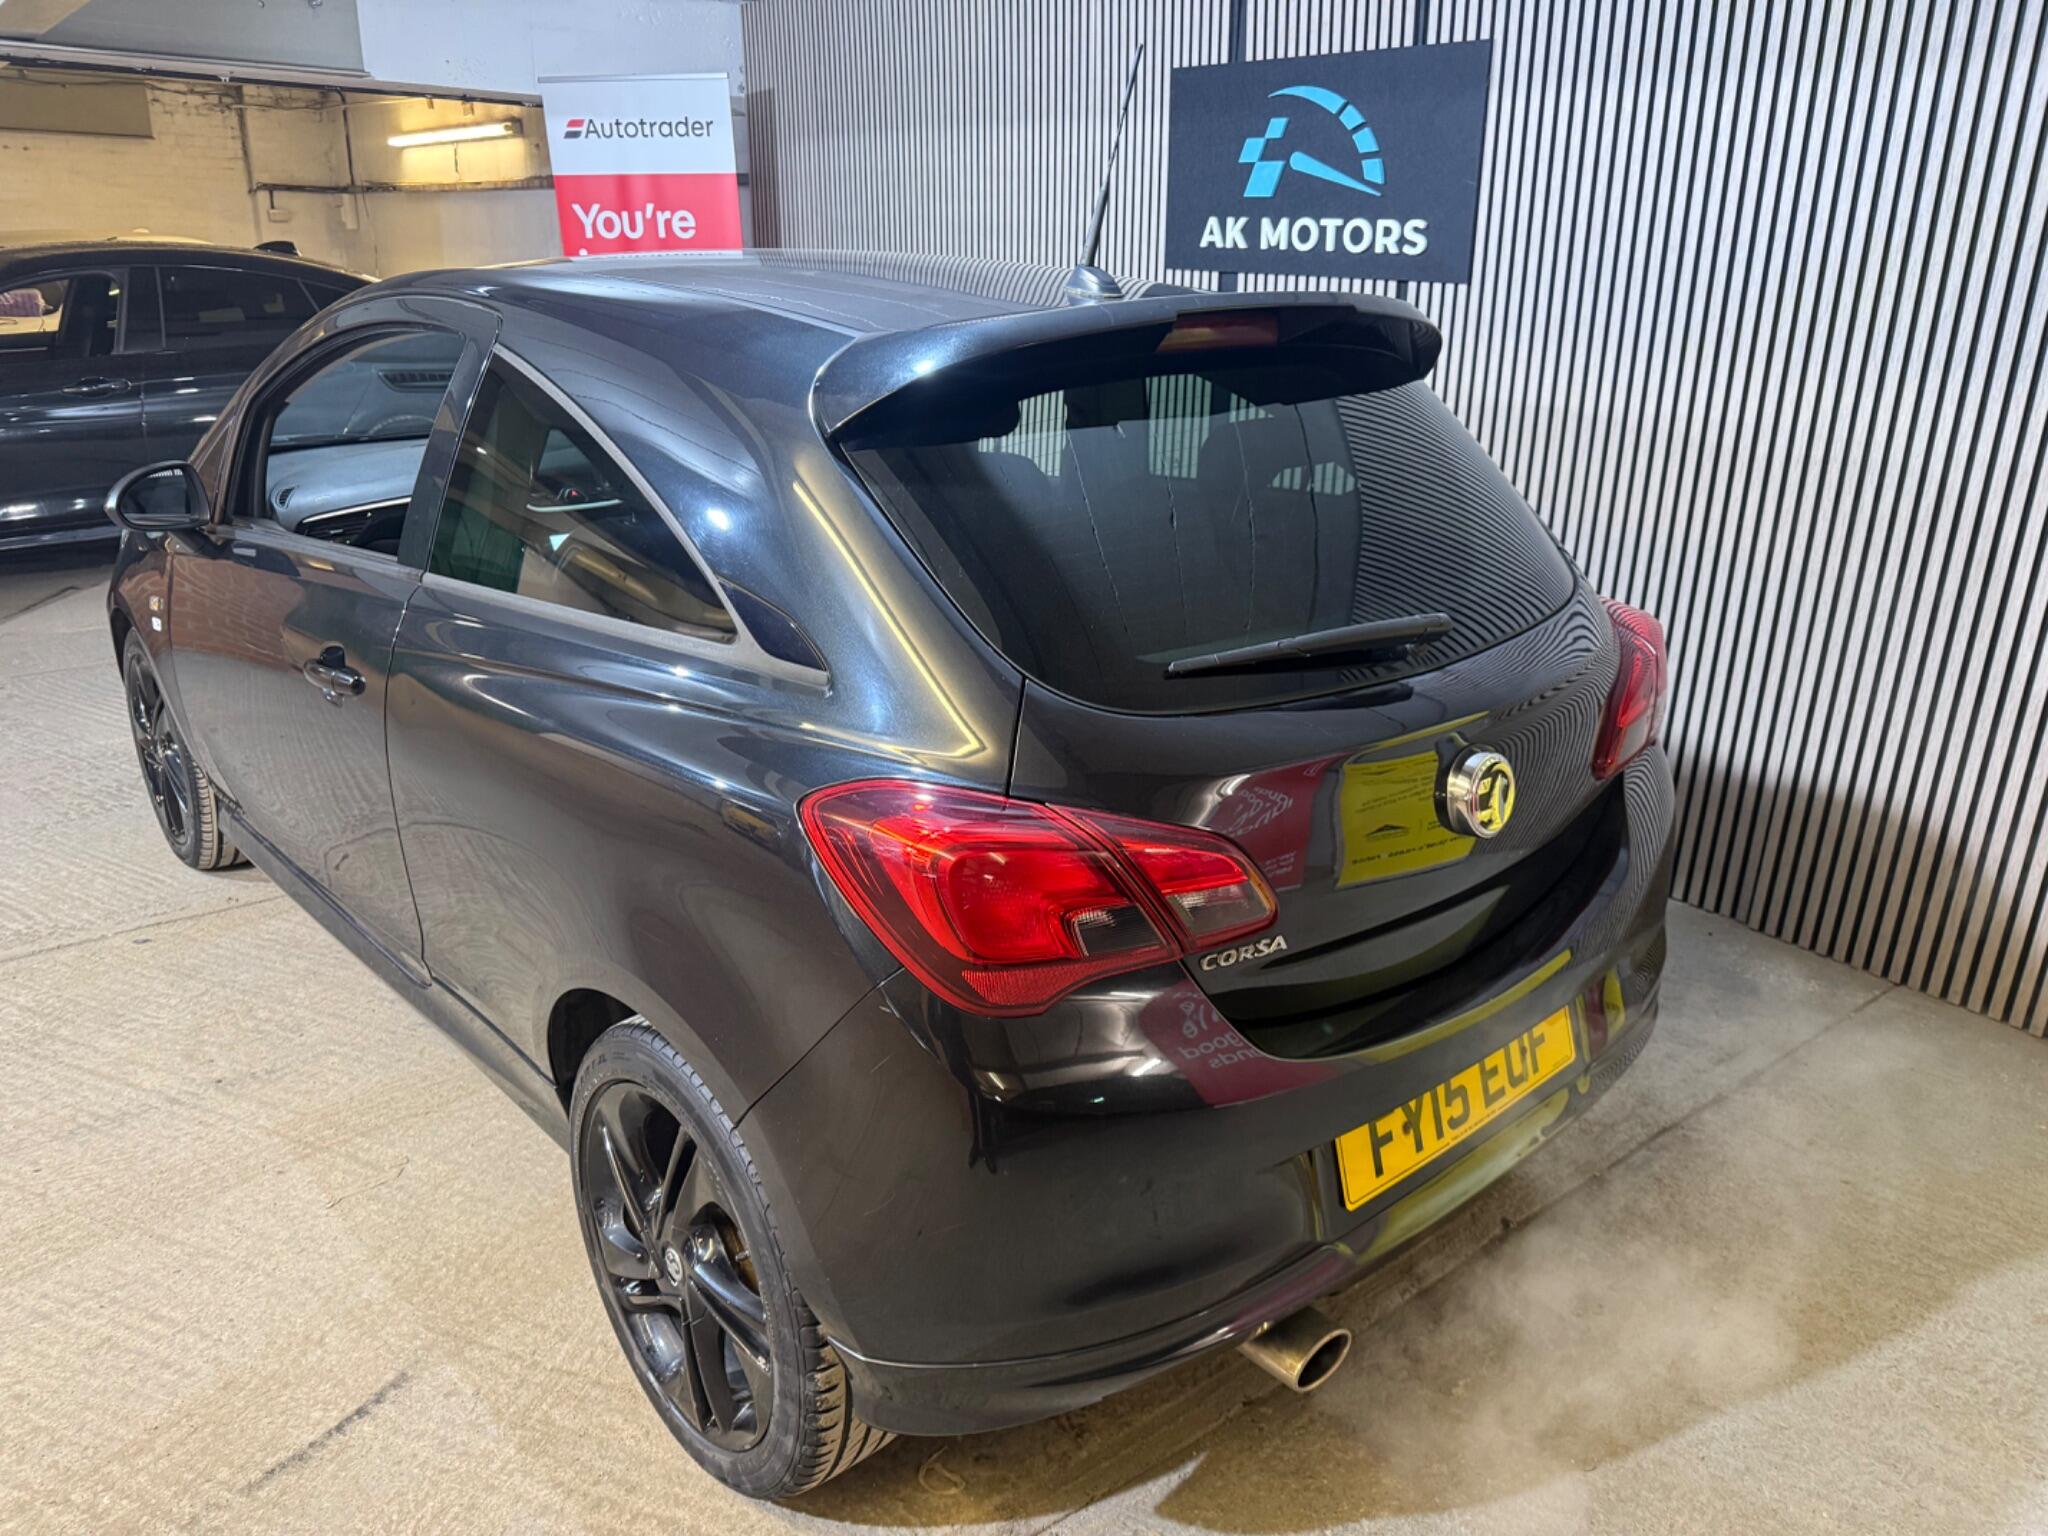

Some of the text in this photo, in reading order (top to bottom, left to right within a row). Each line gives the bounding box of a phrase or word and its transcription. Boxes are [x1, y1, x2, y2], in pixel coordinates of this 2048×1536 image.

[584, 116, 713, 139] Autotrader
[571, 203, 696, 239] You're
[1199, 216, 1429, 256] AK MOTORS
[1201, 935, 1288, 971] CORSA
[1368, 1026, 1547, 1178] FY15 EUF
